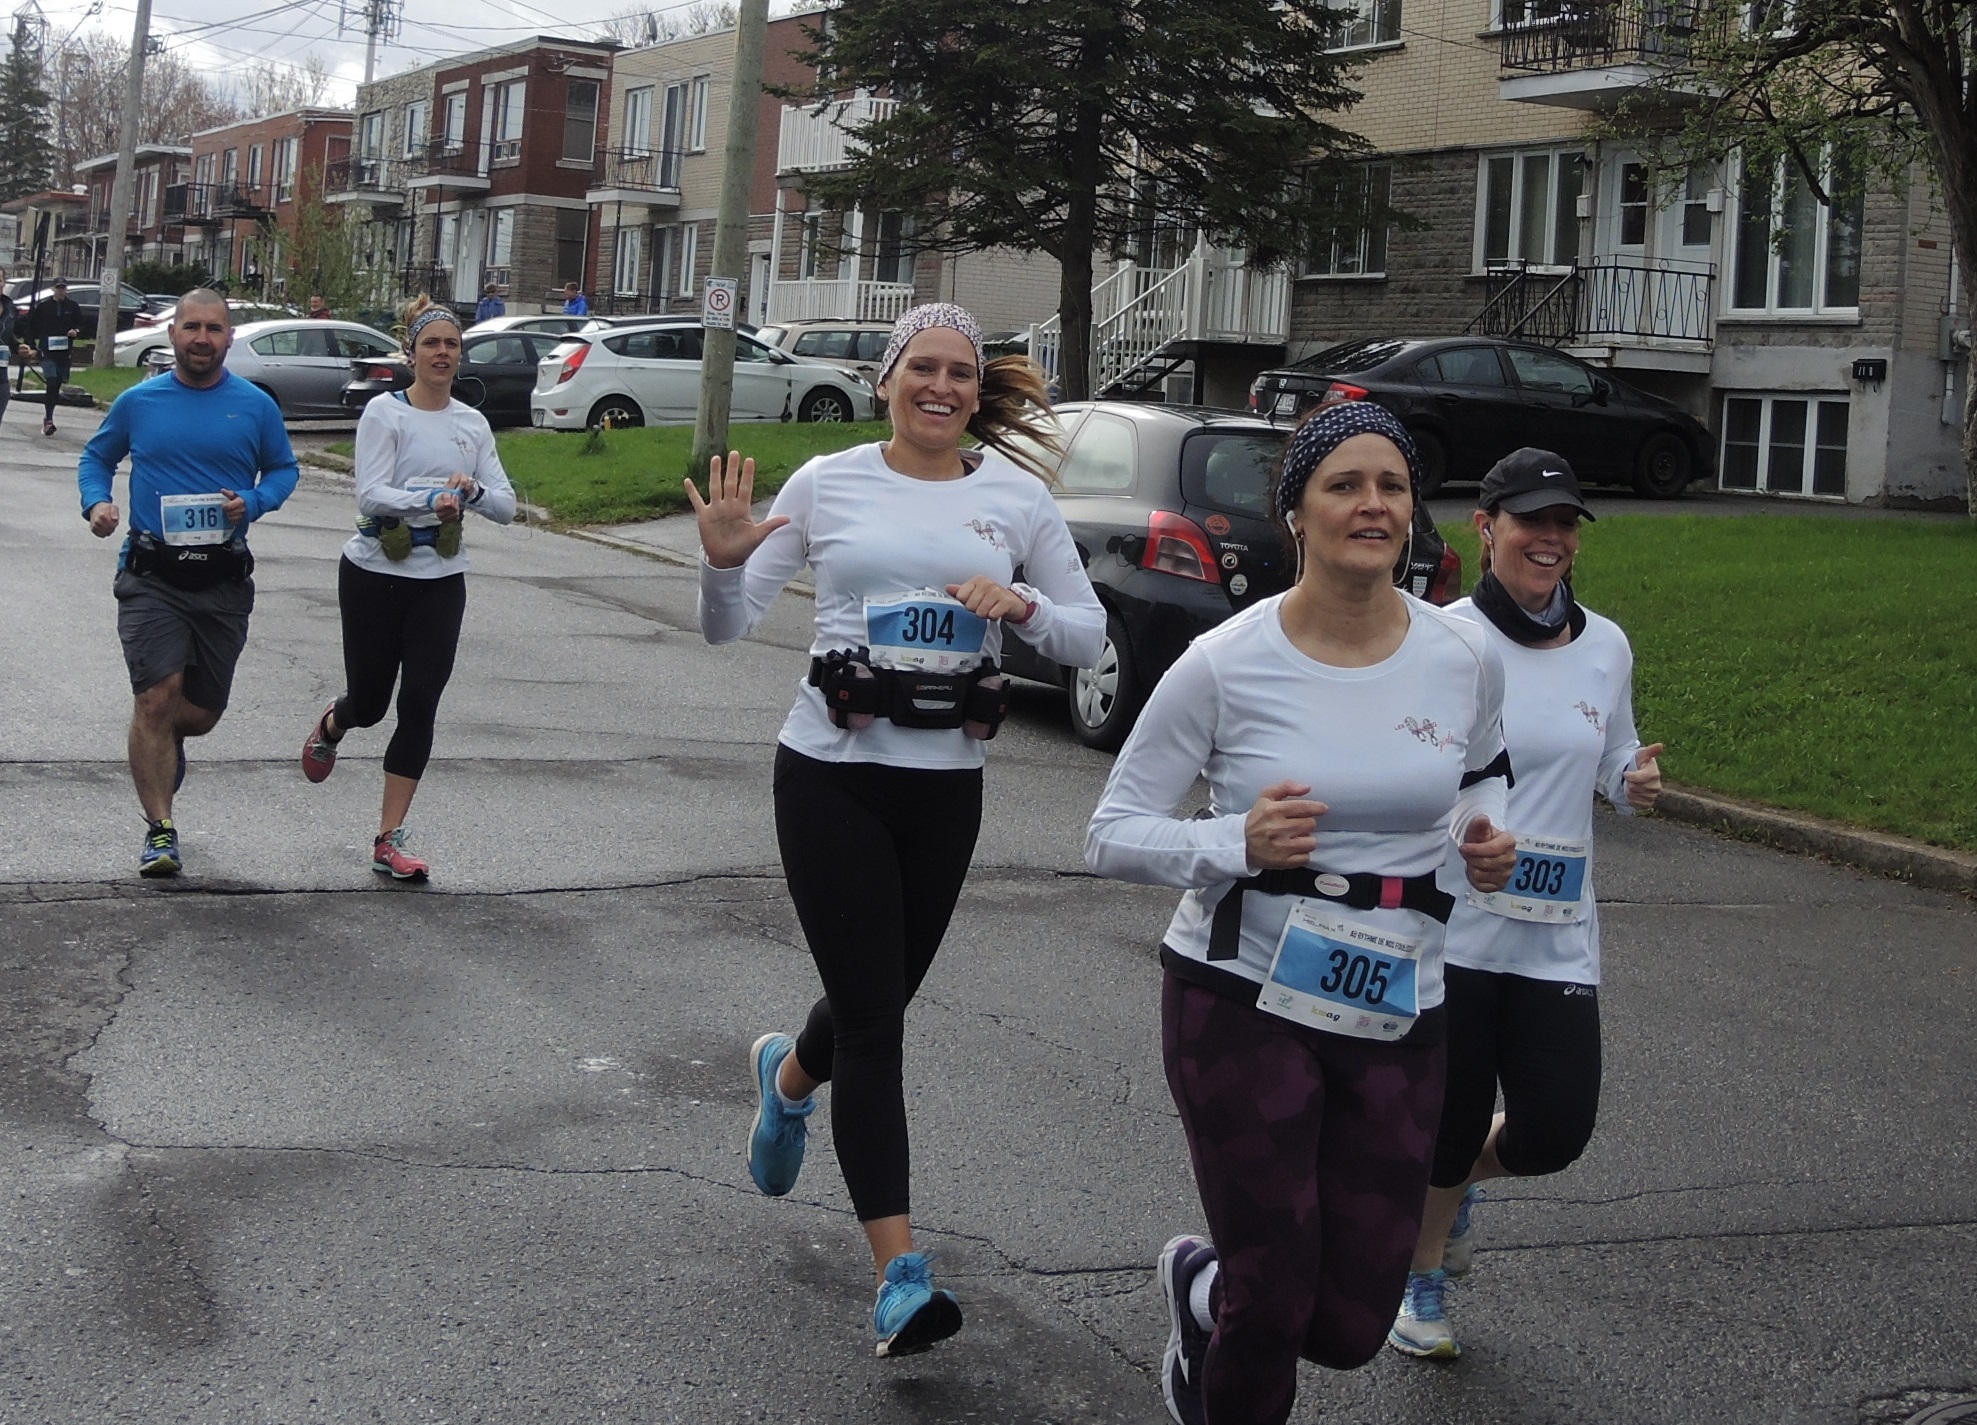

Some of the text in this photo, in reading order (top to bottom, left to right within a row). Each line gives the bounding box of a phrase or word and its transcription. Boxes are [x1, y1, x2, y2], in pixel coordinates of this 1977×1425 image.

[185, 507, 218, 529] 316
[1219, 542, 1249, 551] TOYOTA
[902, 606, 955, 645] 304
[1514, 856, 1566, 895] 303
[1320, 949, 1392, 1005] 305
